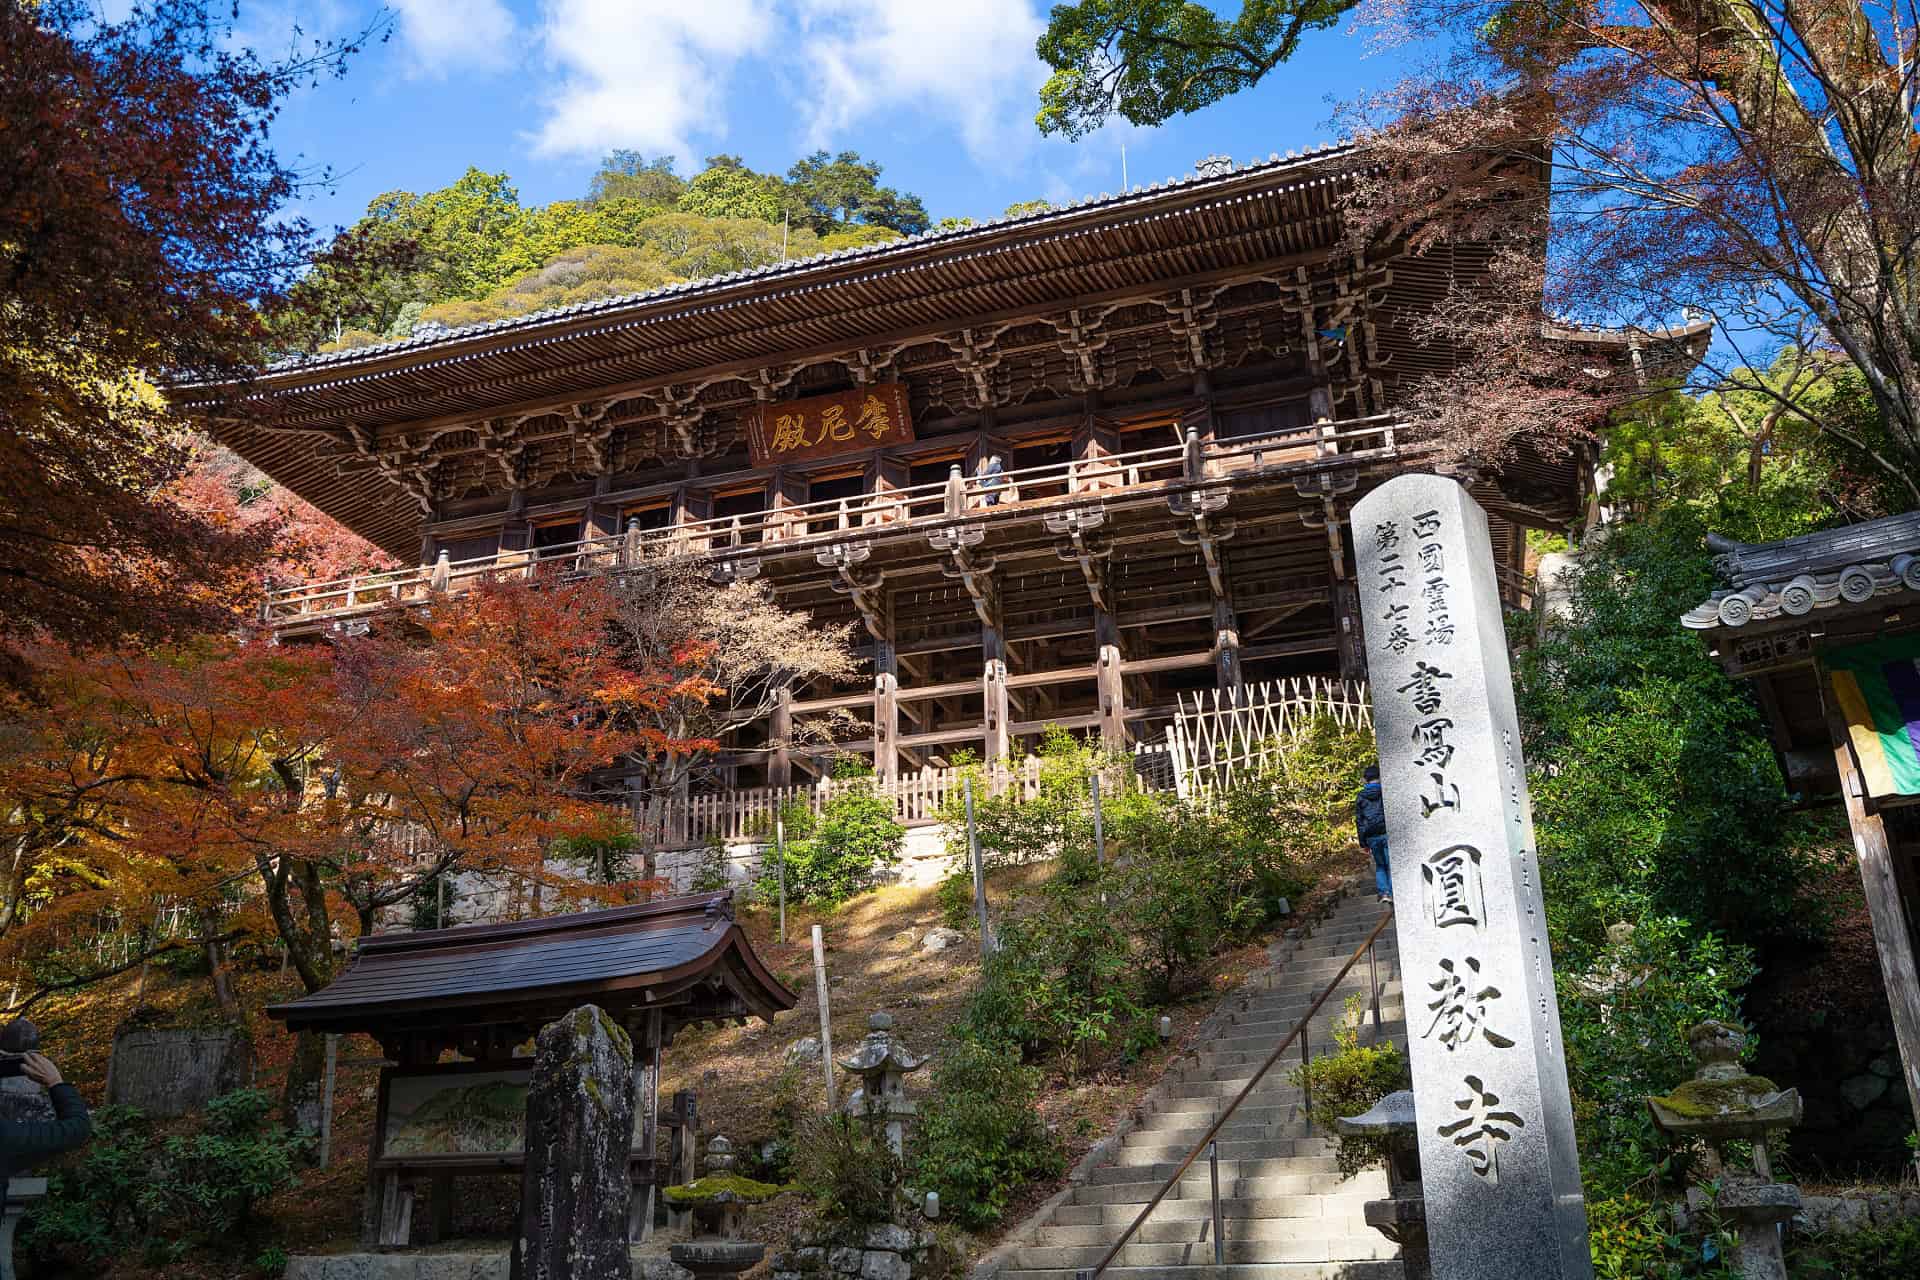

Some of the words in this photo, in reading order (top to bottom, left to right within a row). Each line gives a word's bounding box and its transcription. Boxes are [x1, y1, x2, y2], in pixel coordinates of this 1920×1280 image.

[1375, 521, 1417, 655] 第二十七番
